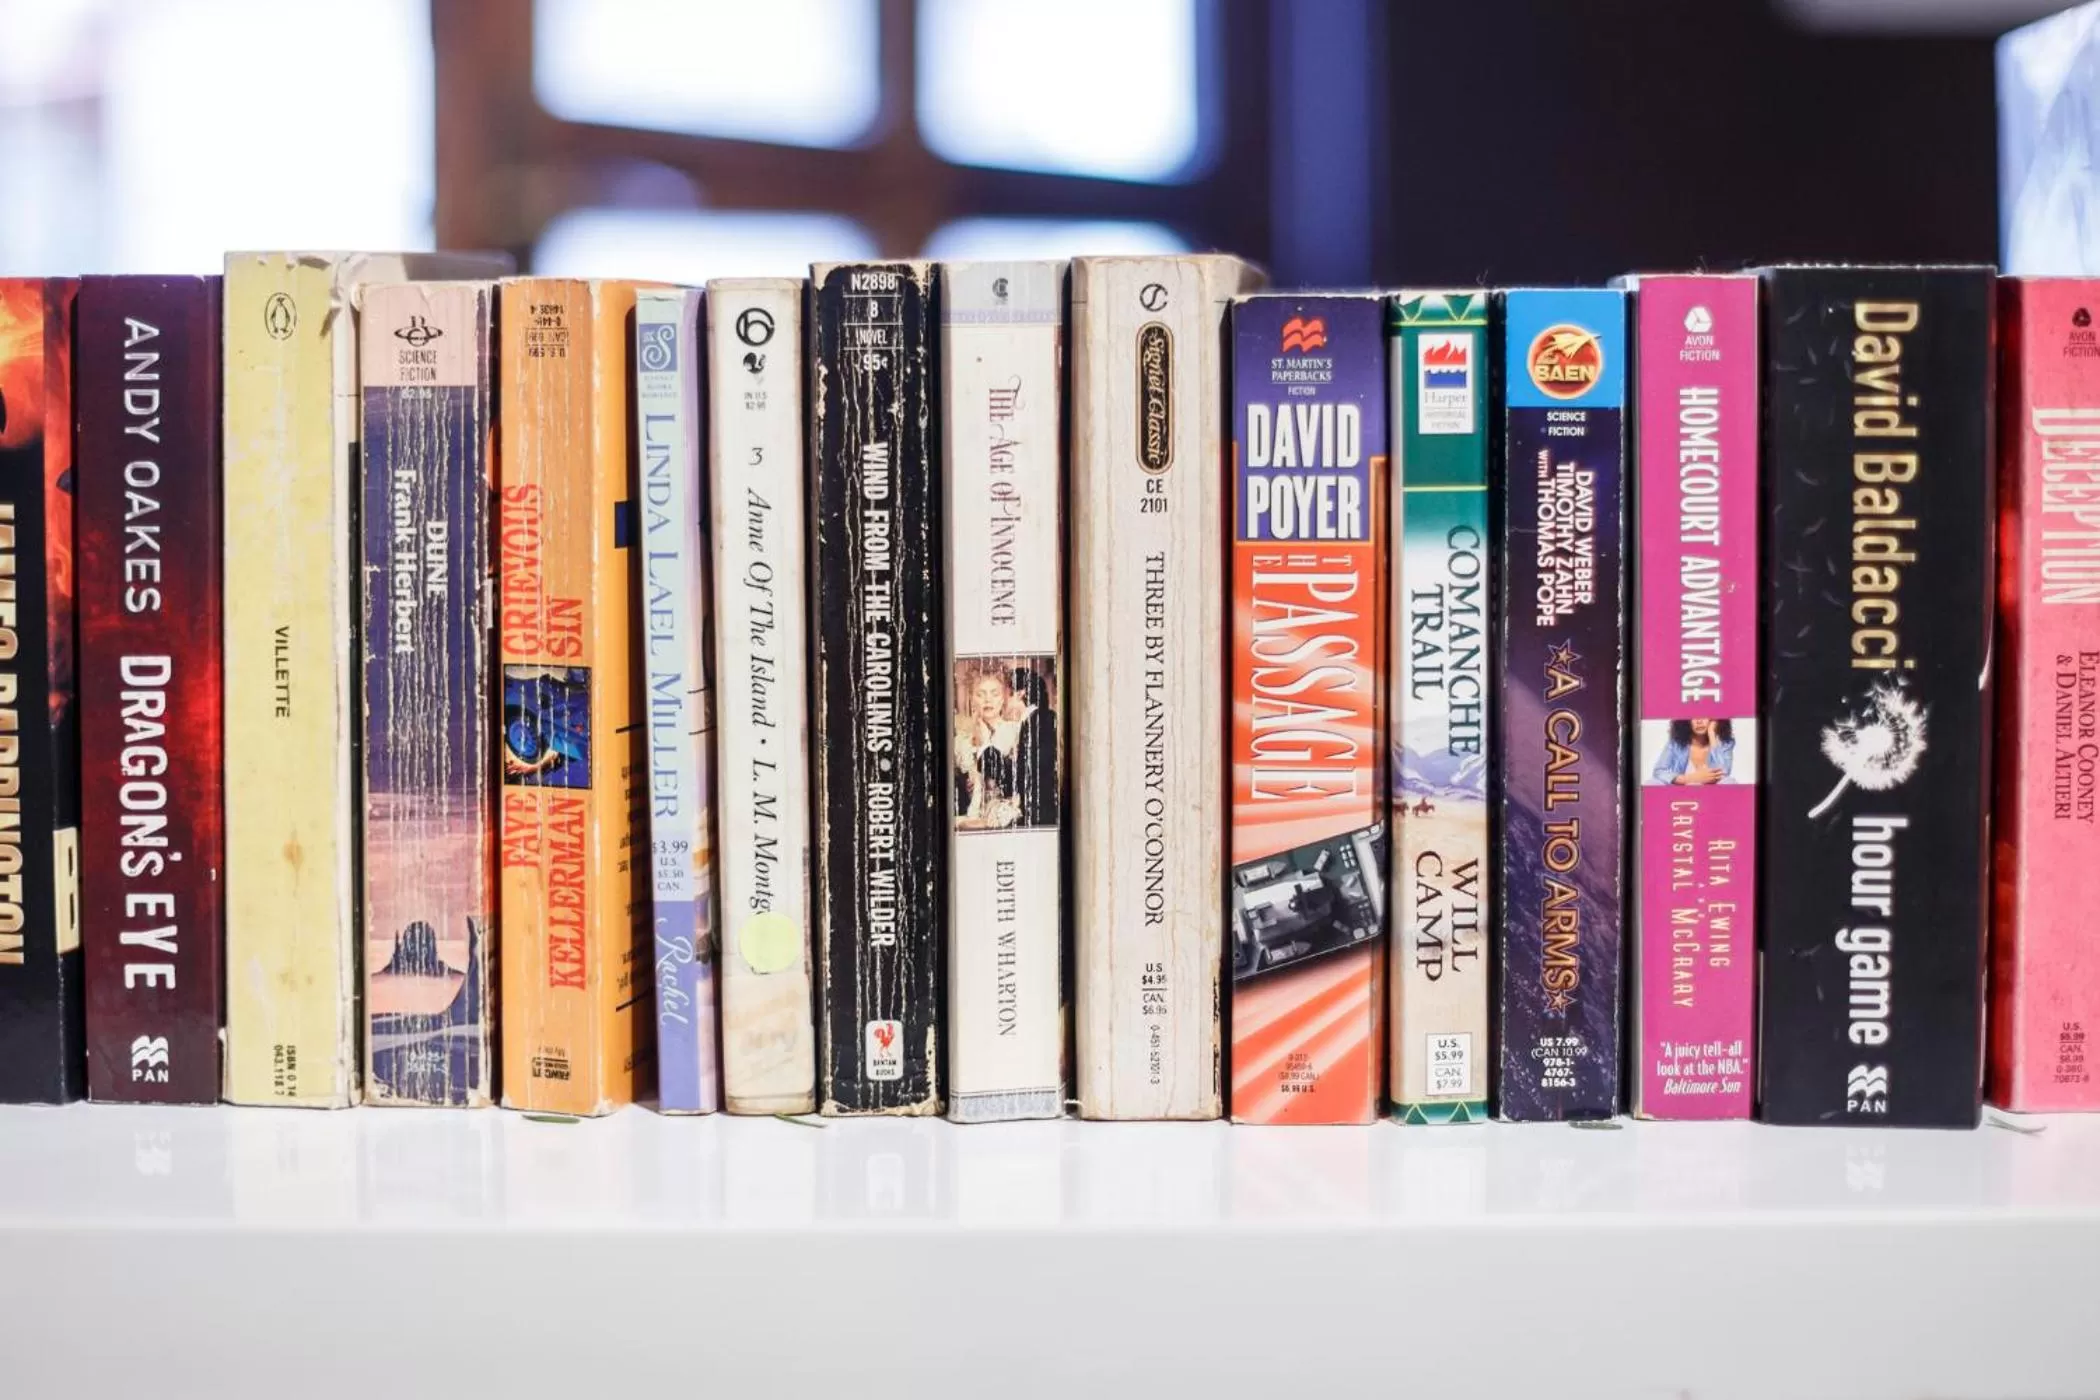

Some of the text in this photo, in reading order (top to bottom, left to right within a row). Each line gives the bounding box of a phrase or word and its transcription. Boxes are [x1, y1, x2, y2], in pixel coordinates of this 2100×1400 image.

[850, 274, 896, 290] N2898
[398, 350, 438, 364] SCIENCE
[400, 367, 437, 380] FICTION
[1271, 358, 1333, 369] ST. MARTIN'S
[1271, 370, 1332, 381] PAPERBACKS
[1534, 364, 1596, 382] BAEN
[1680, 350, 1720, 362] FICTION
[1685, 336, 1714, 346] AVON
[2068, 331, 2096, 342] AVON
[1143, 336, 1166, 465] Signet Classic
[1247, 404, 1360, 468] DAVID
[1288, 386, 1316, 396] FICTION
[1546, 411, 1586, 422] SCIENCE
[1548, 426, 1585, 436] FICTION
[124, 317, 162, 614] ANDY OAKES
[645, 414, 676, 535] LINDA
[750, 447, 764, 466] 3
[989, 375, 1025, 626] THE AGE OF INNOCENCE
[1146, 479, 1164, 494] CE
[1851, 302, 1919, 669] David Baldacci
[1140, 498, 1168, 514] 2101
[1247, 474, 1361, 540] POYER
[1536, 450, 1556, 626] WITH THOMAS POPE
[1556, 461, 1576, 615] TIMOTHY ZAHN
[1574, 471, 1594, 605] DAVID WEBER
[1680, 388, 1720, 703] HOMECOURT ADVANTAGE
[394, 470, 418, 654] Frank Herbert
[427, 520, 448, 599] DUNE
[502, 483, 543, 658] GRIEVOUS
[648, 551, 679, 656] LAEL
[275, 626, 290, 719] VILLETTE
[546, 596, 584, 659] SIN
[1411, 583, 1444, 700] TRAIL
[1446, 524, 1480, 756] COMANCHE
[742, 488, 780, 916] Anne Of The Island L. M. Montg
[863, 442, 896, 947] WIND FROM THE CAROLINAS ROBERT WILDER
[1250, 571, 1360, 800] PASSAGE
[651, 672, 682, 820] MILLER
[1144, 552, 1164, 927] THREE BY FLANNERY O'CONNOR
[2054, 654, 2076, 820] & DANIEL ALTIERI
[2076, 650, 2100, 824] ELEANOR COONEY
[118, 655, 182, 990] DRAGON'S EYE
[503, 792, 538, 870] FAYE
[652, 840, 688, 854] $3.99
[1542, 665, 1582, 992] A CALL TO ARMS
[1671, 801, 1698, 891] CRYSTAL
[550, 796, 586, 992] KELLERMAN
[1415, 850, 1443, 982] CAMP
[1450, 857, 1478, 973] WILL
[1708, 840, 1736, 968] RITA EWING
[1834, 816, 1909, 1047] hour game
[655, 918, 692, 1025] Rachel
[996, 860, 1017, 1036] EDITH WHARTON
[132, 1068, 169, 1083] PAN
[286, 1044, 296, 1070] ISBN
[1434, 1050, 1464, 1061] $5.99
[1540, 1037, 1579, 1047] US 7.99
[1541, 1078, 1576, 1088] 8156-3
[1656, 1060, 1680, 1077] look
[1683, 1062, 1695, 1076] at
[1697, 1060, 1715, 1076] the
[1664, 1076, 1742, 1095] Baltimore Sun
[1674, 1042, 1700, 1061] juicy
[1703, 1040, 1743, 1057] tell-all
[1847, 1100, 1887, 1113] PAN
